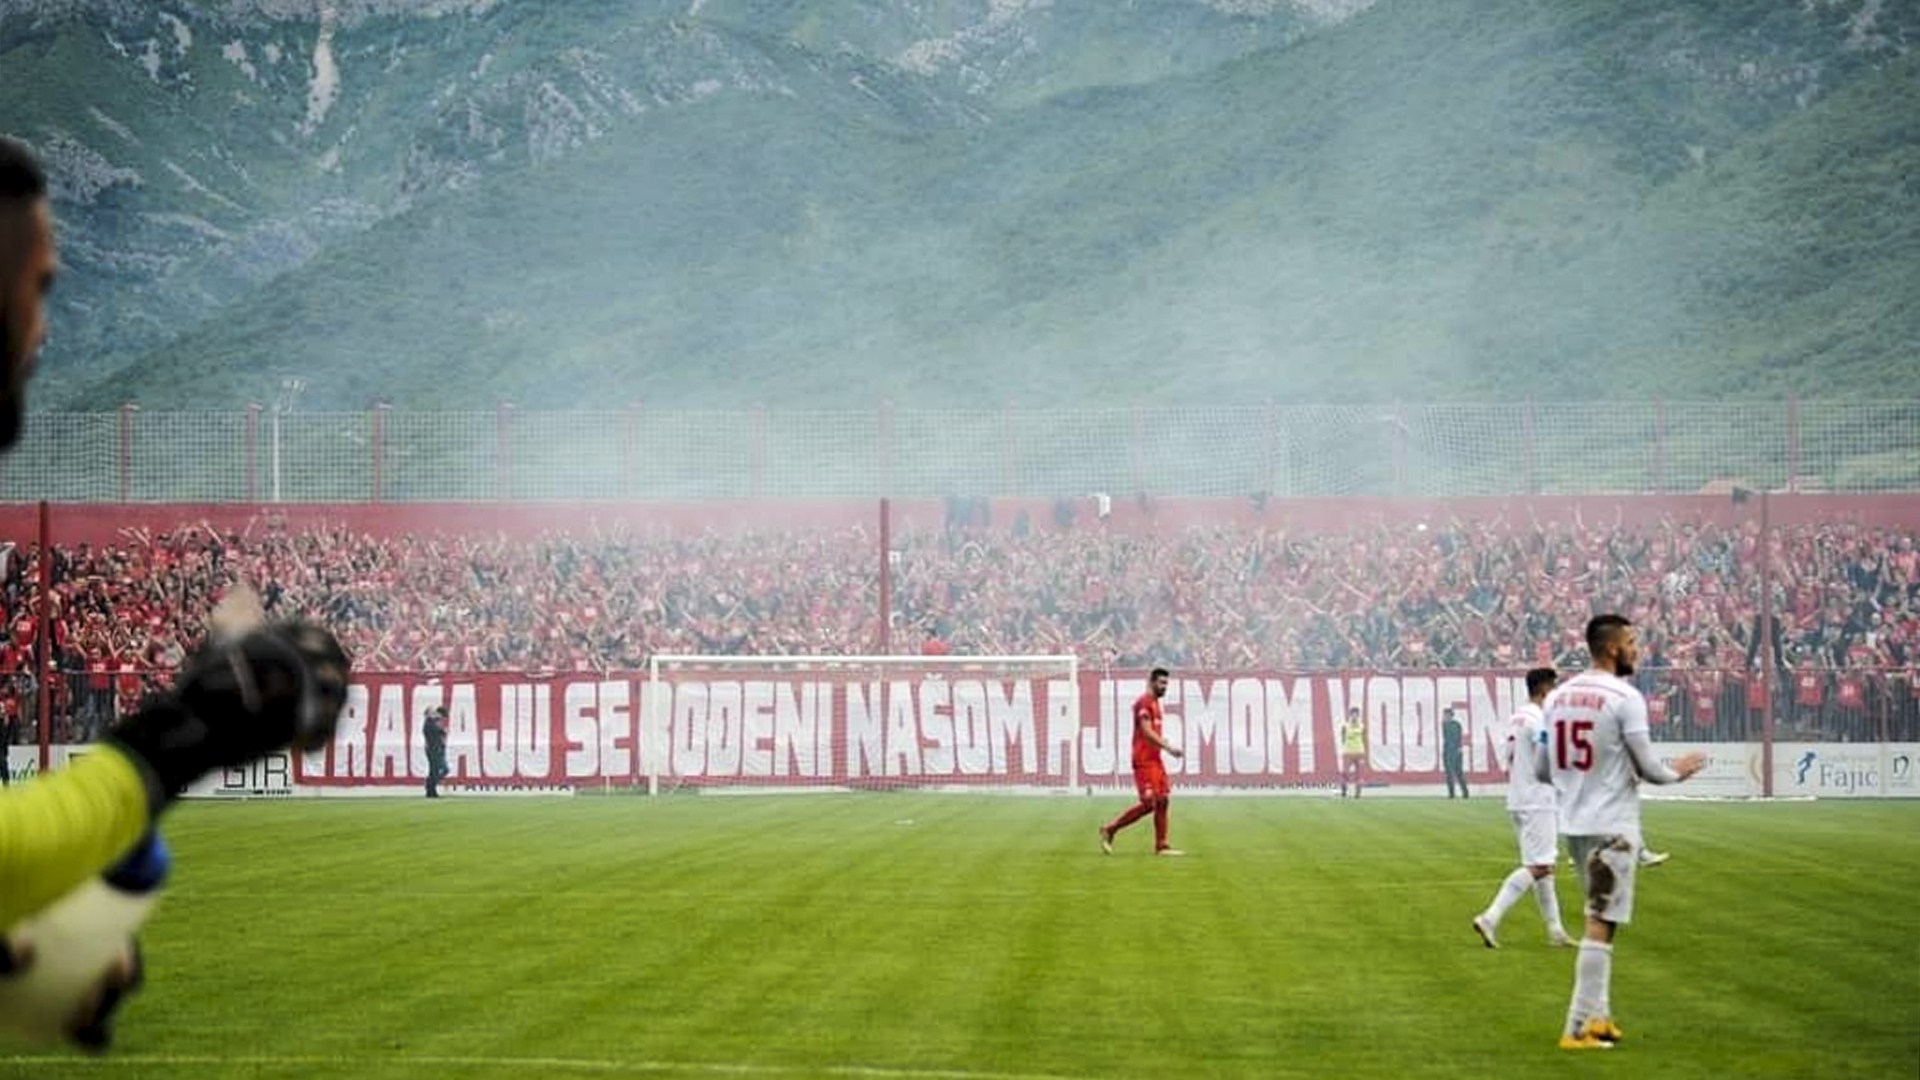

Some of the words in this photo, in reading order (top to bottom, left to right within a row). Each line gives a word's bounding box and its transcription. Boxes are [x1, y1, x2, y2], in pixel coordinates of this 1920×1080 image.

[564, 680, 632, 776] SE
[846, 672, 1037, 776] NAŠOM
[1555, 720, 1594, 771] 15
